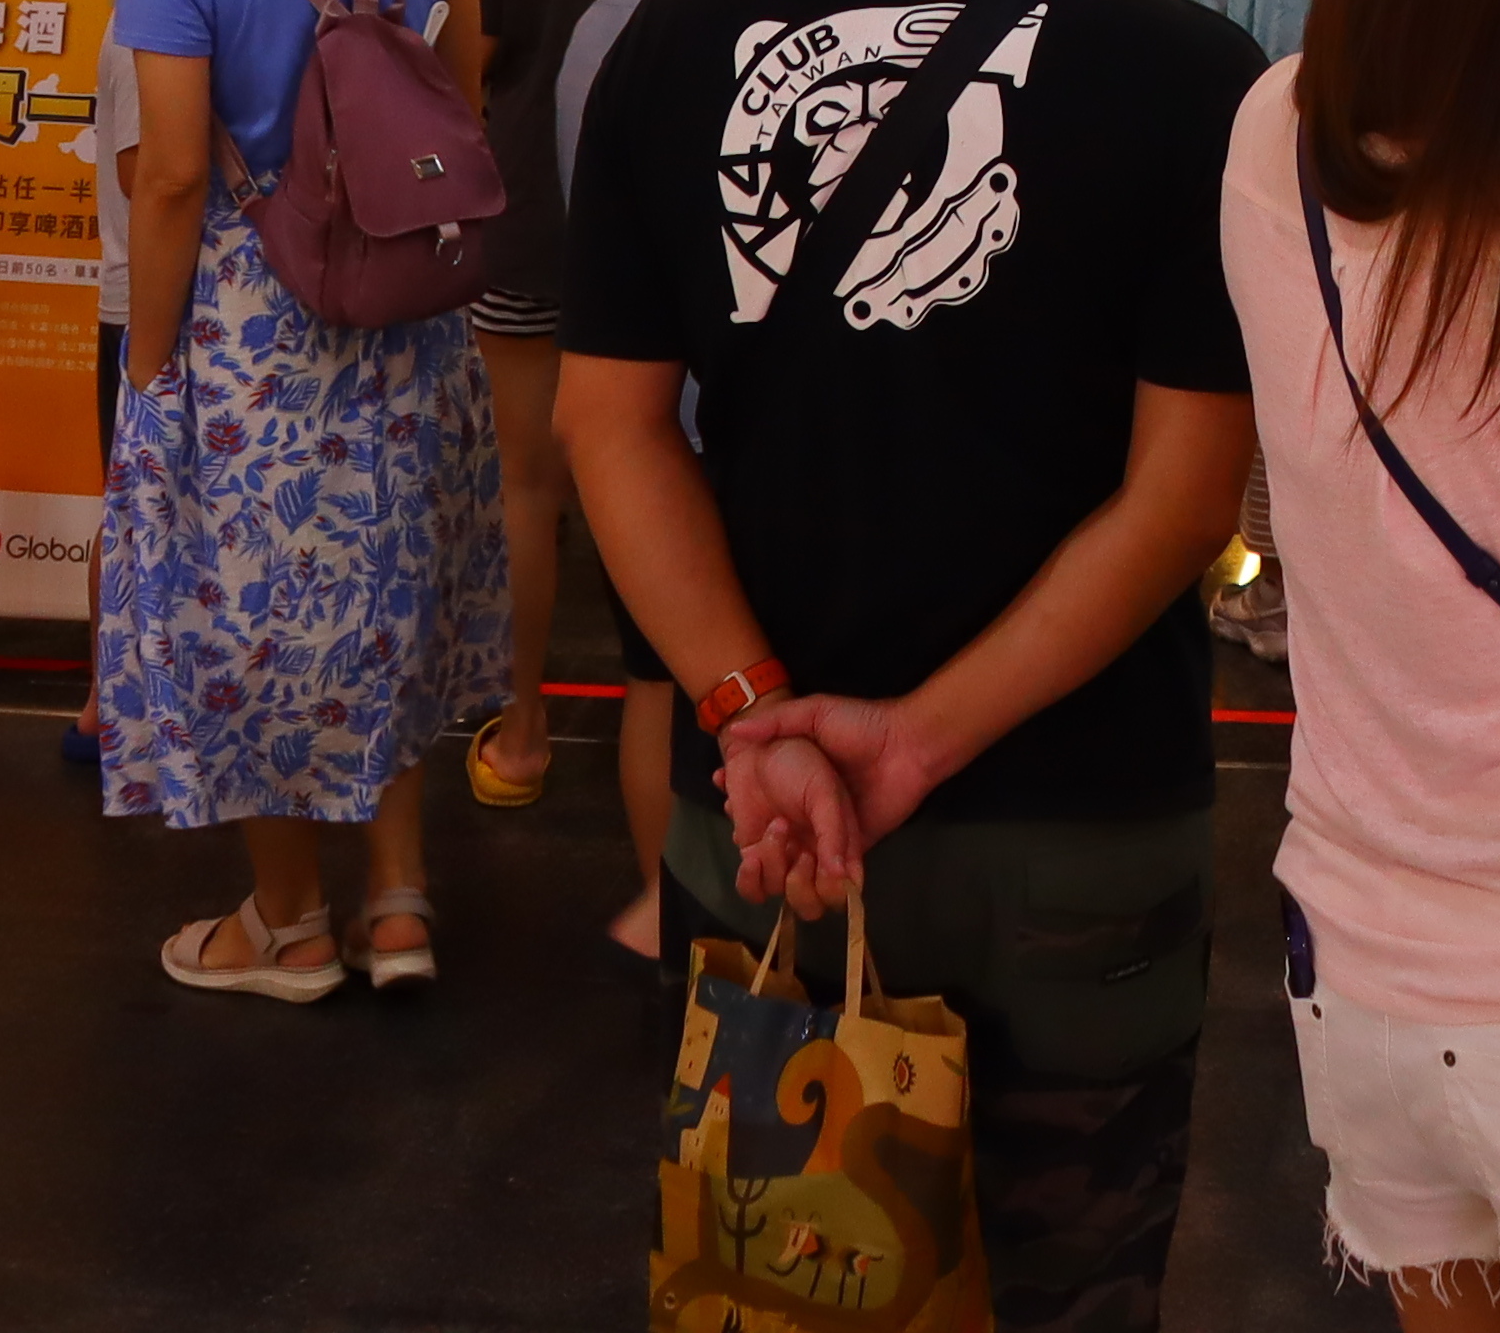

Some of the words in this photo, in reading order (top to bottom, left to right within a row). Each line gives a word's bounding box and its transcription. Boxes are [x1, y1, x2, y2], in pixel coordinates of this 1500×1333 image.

[741, 23, 841, 117] CLUB
[756, 44, 883, 145] TAIWAN
[5, 533, 91, 564] Global
